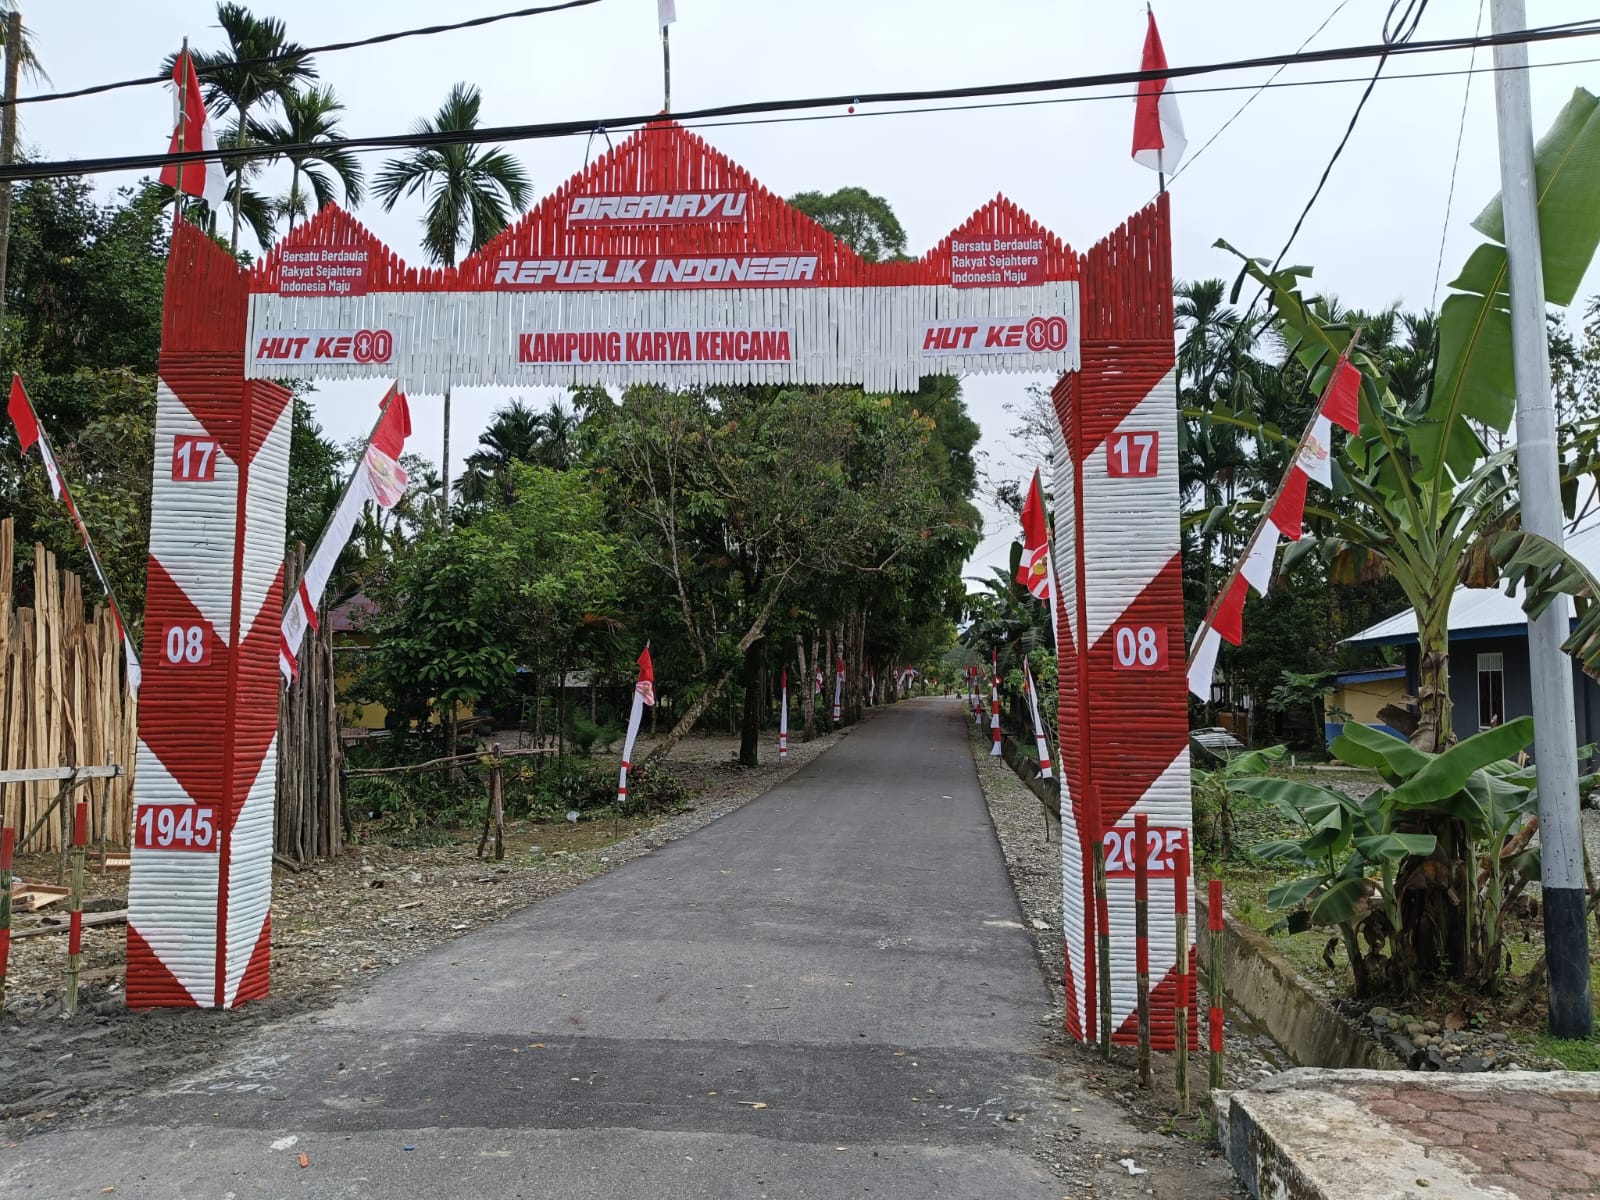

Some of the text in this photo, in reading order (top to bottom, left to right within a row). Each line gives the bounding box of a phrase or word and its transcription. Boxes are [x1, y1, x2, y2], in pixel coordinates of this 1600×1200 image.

[568, 192, 747, 220] DIRGAHAYU
[282, 250, 368, 262] Bersatu Berdaulat
[951, 238, 1043, 252] Bersatu Berdaulat
[281, 265, 362, 279] Rakyat Sejahtera
[493, 256, 818, 285] REPUBLIK INDONESIA
[951, 254, 1038, 270] Rakyat Sejahtera
[280, 280, 351, 295] Indonesia Maju
[952, 270, 1027, 284] Indonesia Maju
[256, 337, 309, 359] HUT
[518, 331, 791, 363] KAMPUNG KARYA KENCANA
[922, 326, 978, 350] HUT
[177, 441, 214, 478] 17
[1113, 435, 1154, 473] 17
[166, 625, 204, 664] 08
[1116, 626, 1158, 667] 08
[140, 808, 213, 847] 1945
